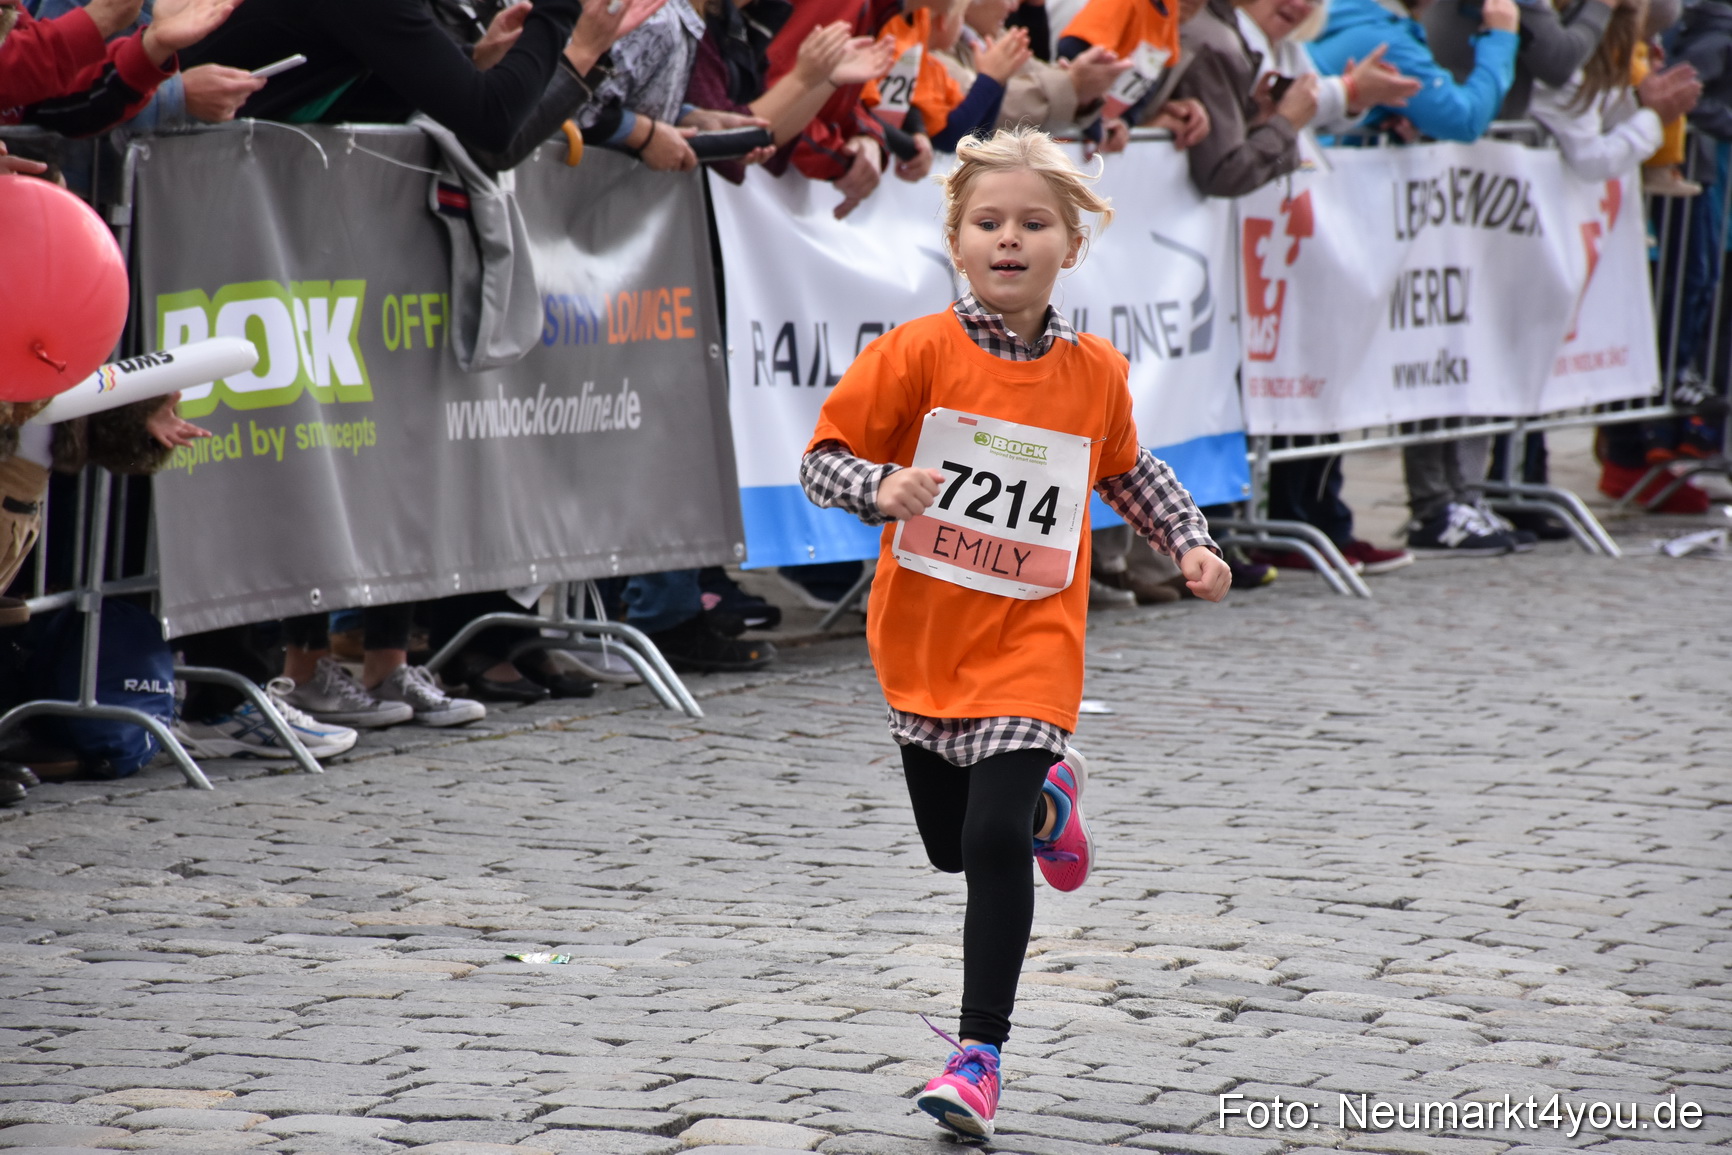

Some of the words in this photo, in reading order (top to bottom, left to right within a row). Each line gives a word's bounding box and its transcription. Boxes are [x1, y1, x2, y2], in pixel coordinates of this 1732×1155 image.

[249, 420, 286, 462] by
[991, 435, 1048, 460] BOCK
[938, 460, 1060, 535] 7214
[933, 525, 1031, 577] EMILY
